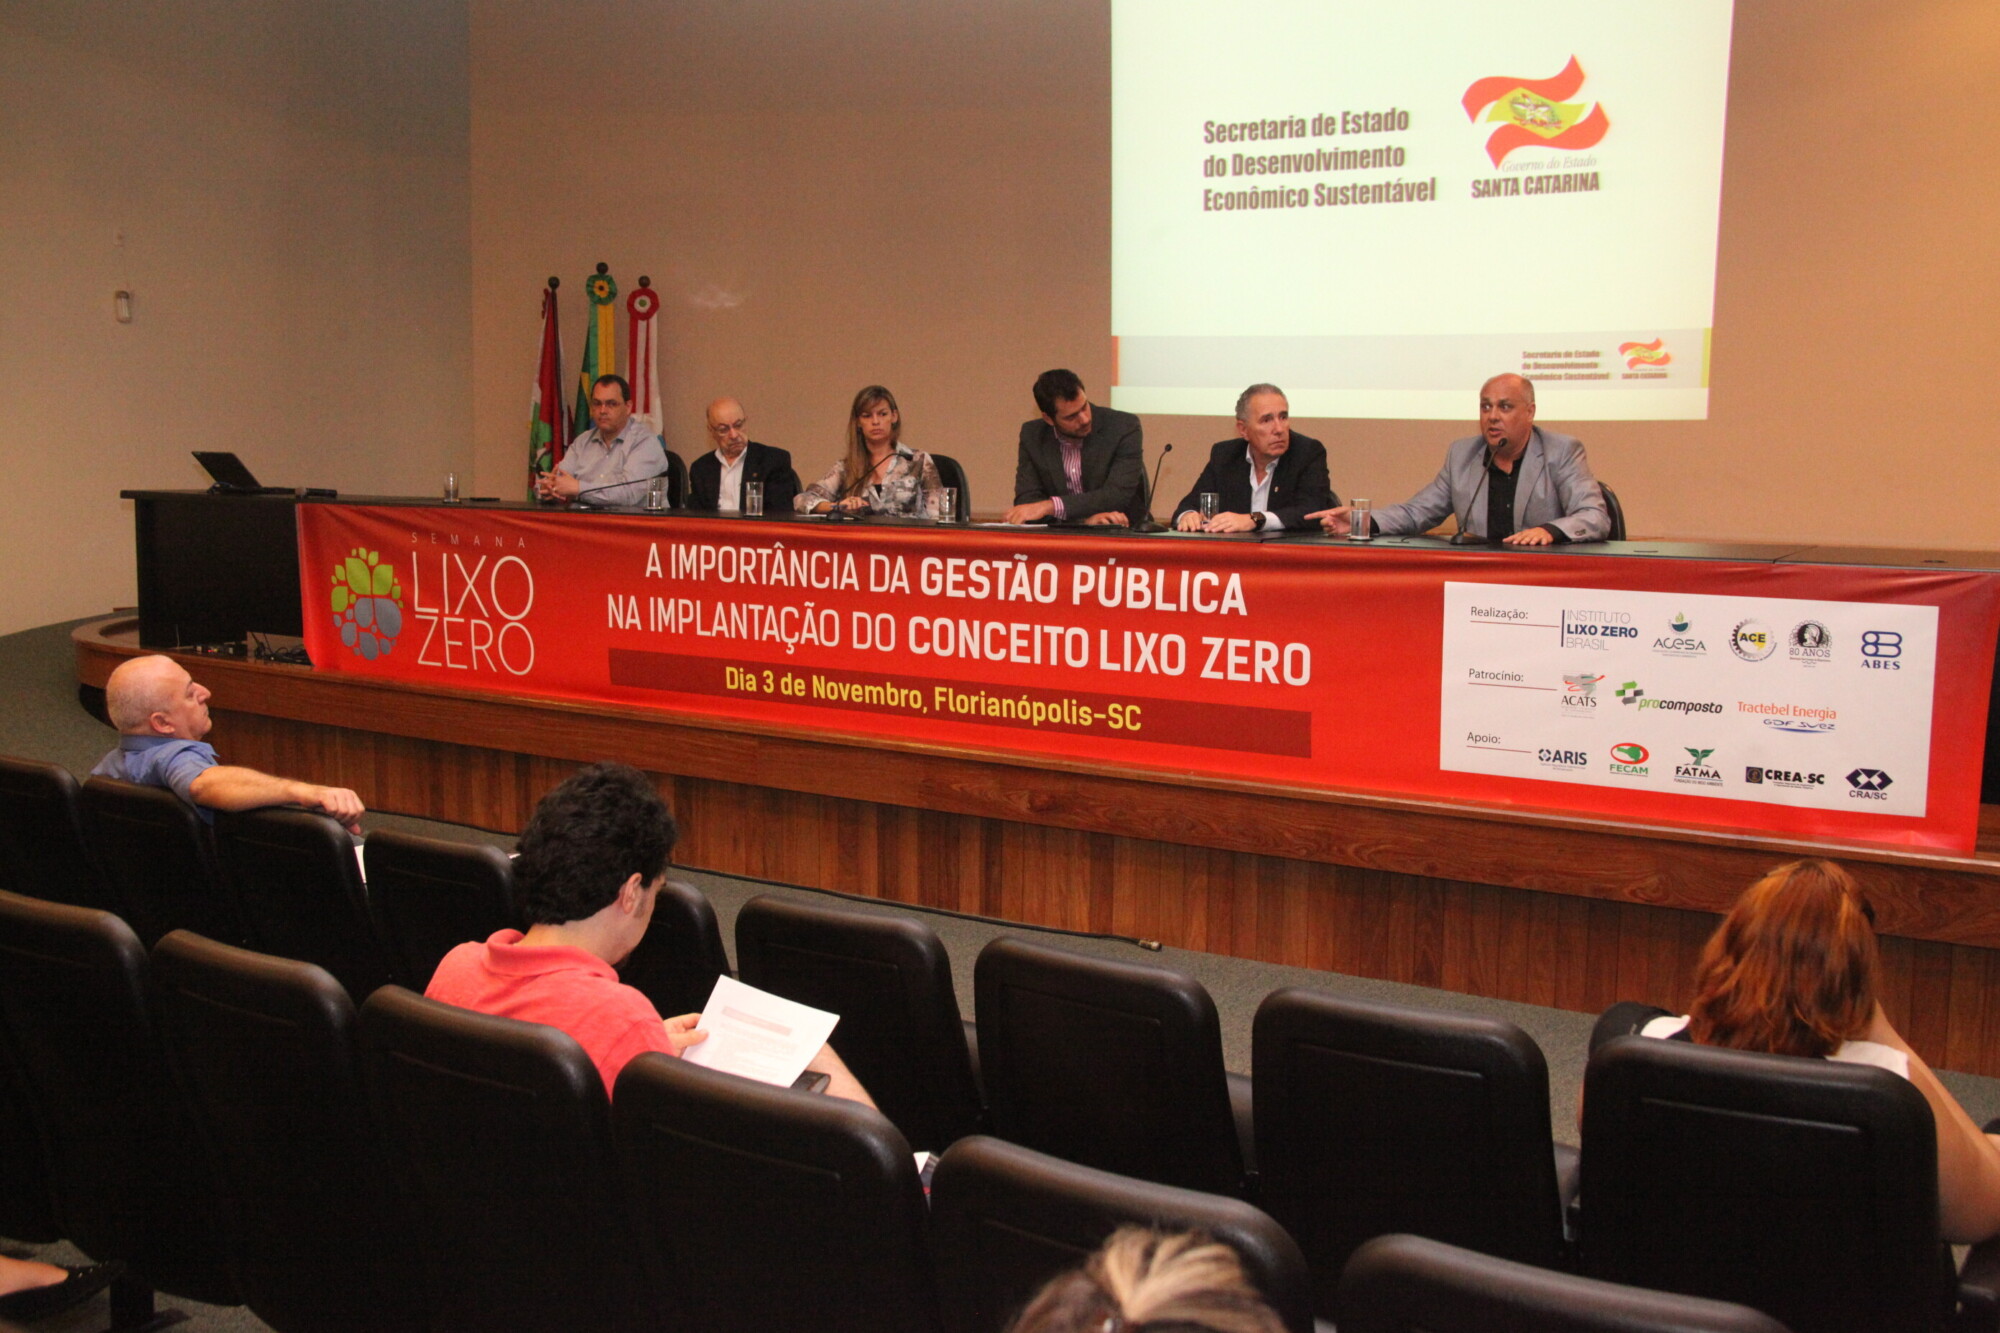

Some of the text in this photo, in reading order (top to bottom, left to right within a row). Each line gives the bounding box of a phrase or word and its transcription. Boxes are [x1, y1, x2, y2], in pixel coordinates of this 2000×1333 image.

[1203, 107, 1409, 144] Secretaria de Estado
[1203, 145, 1405, 178] do Desenvolvimento
[1502, 154, 1597, 173] Governo do Estado
[1471, 171, 1600, 199] SANTA CATARINA
[1203, 177, 1436, 212] Econômico Sustentável
[412, 532, 525, 549] SEMANA
[412, 551, 534, 621] LIXO
[646, 541, 1247, 616] A IMPORTÂNCIA DA GESTÃO PÚBLICA
[1470, 606, 1528, 621] Realização:
[1567, 609, 1631, 624] INSTITUTO
[1567, 624, 1638, 638] LIXO ZERO
[1740, 633, 1766, 643] ACE
[414, 614, 535, 676] ZERO
[607, 594, 1311, 687] NA IMPLANTAÇÃO DO CONCEITO LIXO ZERO
[1566, 637, 1610, 651] BRASIL
[1789, 648, 1831, 658] 80 ANOS
[1861, 659, 1901, 670] ABES
[1469, 668, 1524, 682] Patrocínio:
[725, 666, 756, 692] Dia
[763, 671, 775, 694] 3
[780, 672, 806, 696] de
[812, 675, 927, 715] Novembro,
[1561, 695, 1597, 708] ACATS
[1638, 697, 1723, 715] procomposto
[1738, 701, 1837, 721] Tractebel Energia
[1467, 732, 1501, 745] Apoio:
[1552, 750, 1588, 766] ARIS
[1610, 764, 1649, 775] FECAM
[1675, 766, 1722, 780] FATMA
[1765, 769, 1825, 785] CREA-SC
[1849, 790, 1888, 801] CRA/SC
